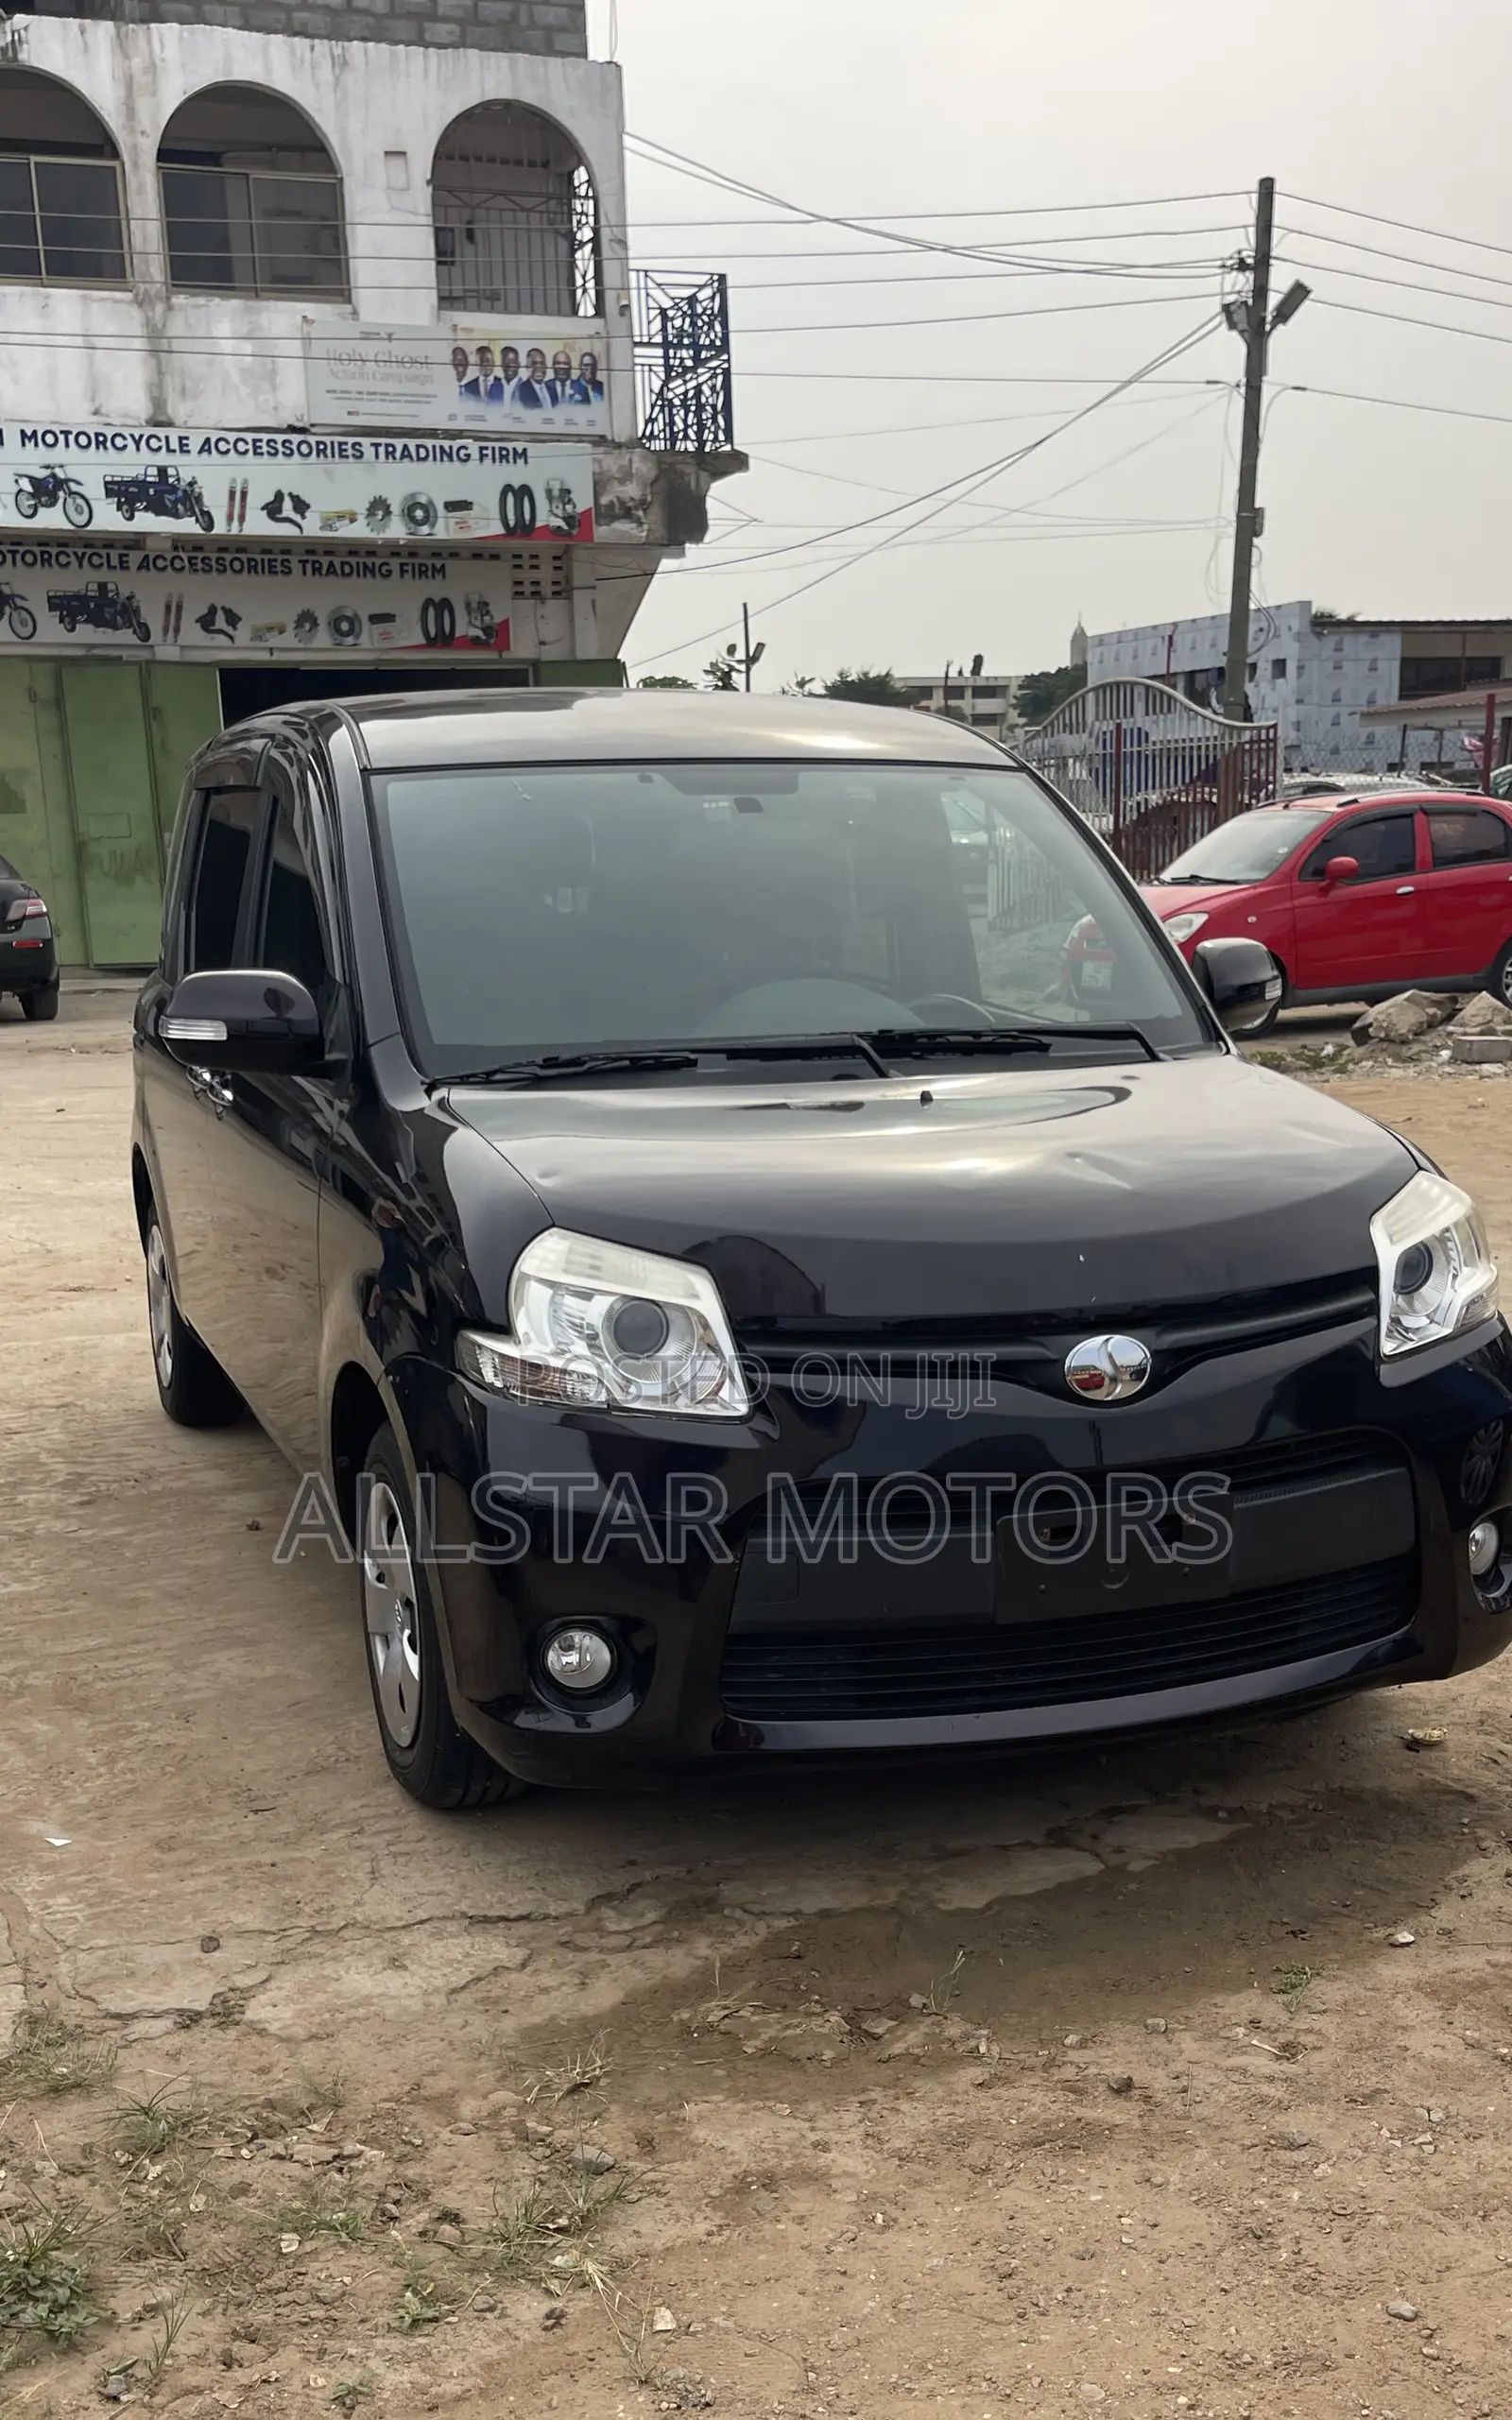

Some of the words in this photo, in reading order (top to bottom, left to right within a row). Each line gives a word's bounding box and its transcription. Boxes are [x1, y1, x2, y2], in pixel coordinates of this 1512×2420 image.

[373, 349, 434, 371] Ghost
[19, 428, 191, 454] MOTORCYCLE
[197, 435, 365, 460] ACCESSORIES
[370, 441, 472, 463] TRADING
[478, 445, 529, 465] FIRM
[136, 553, 293, 576] ACCESSORIES
[298, 558, 393, 579] TRADING
[399, 561, 447, 580] FIRM
